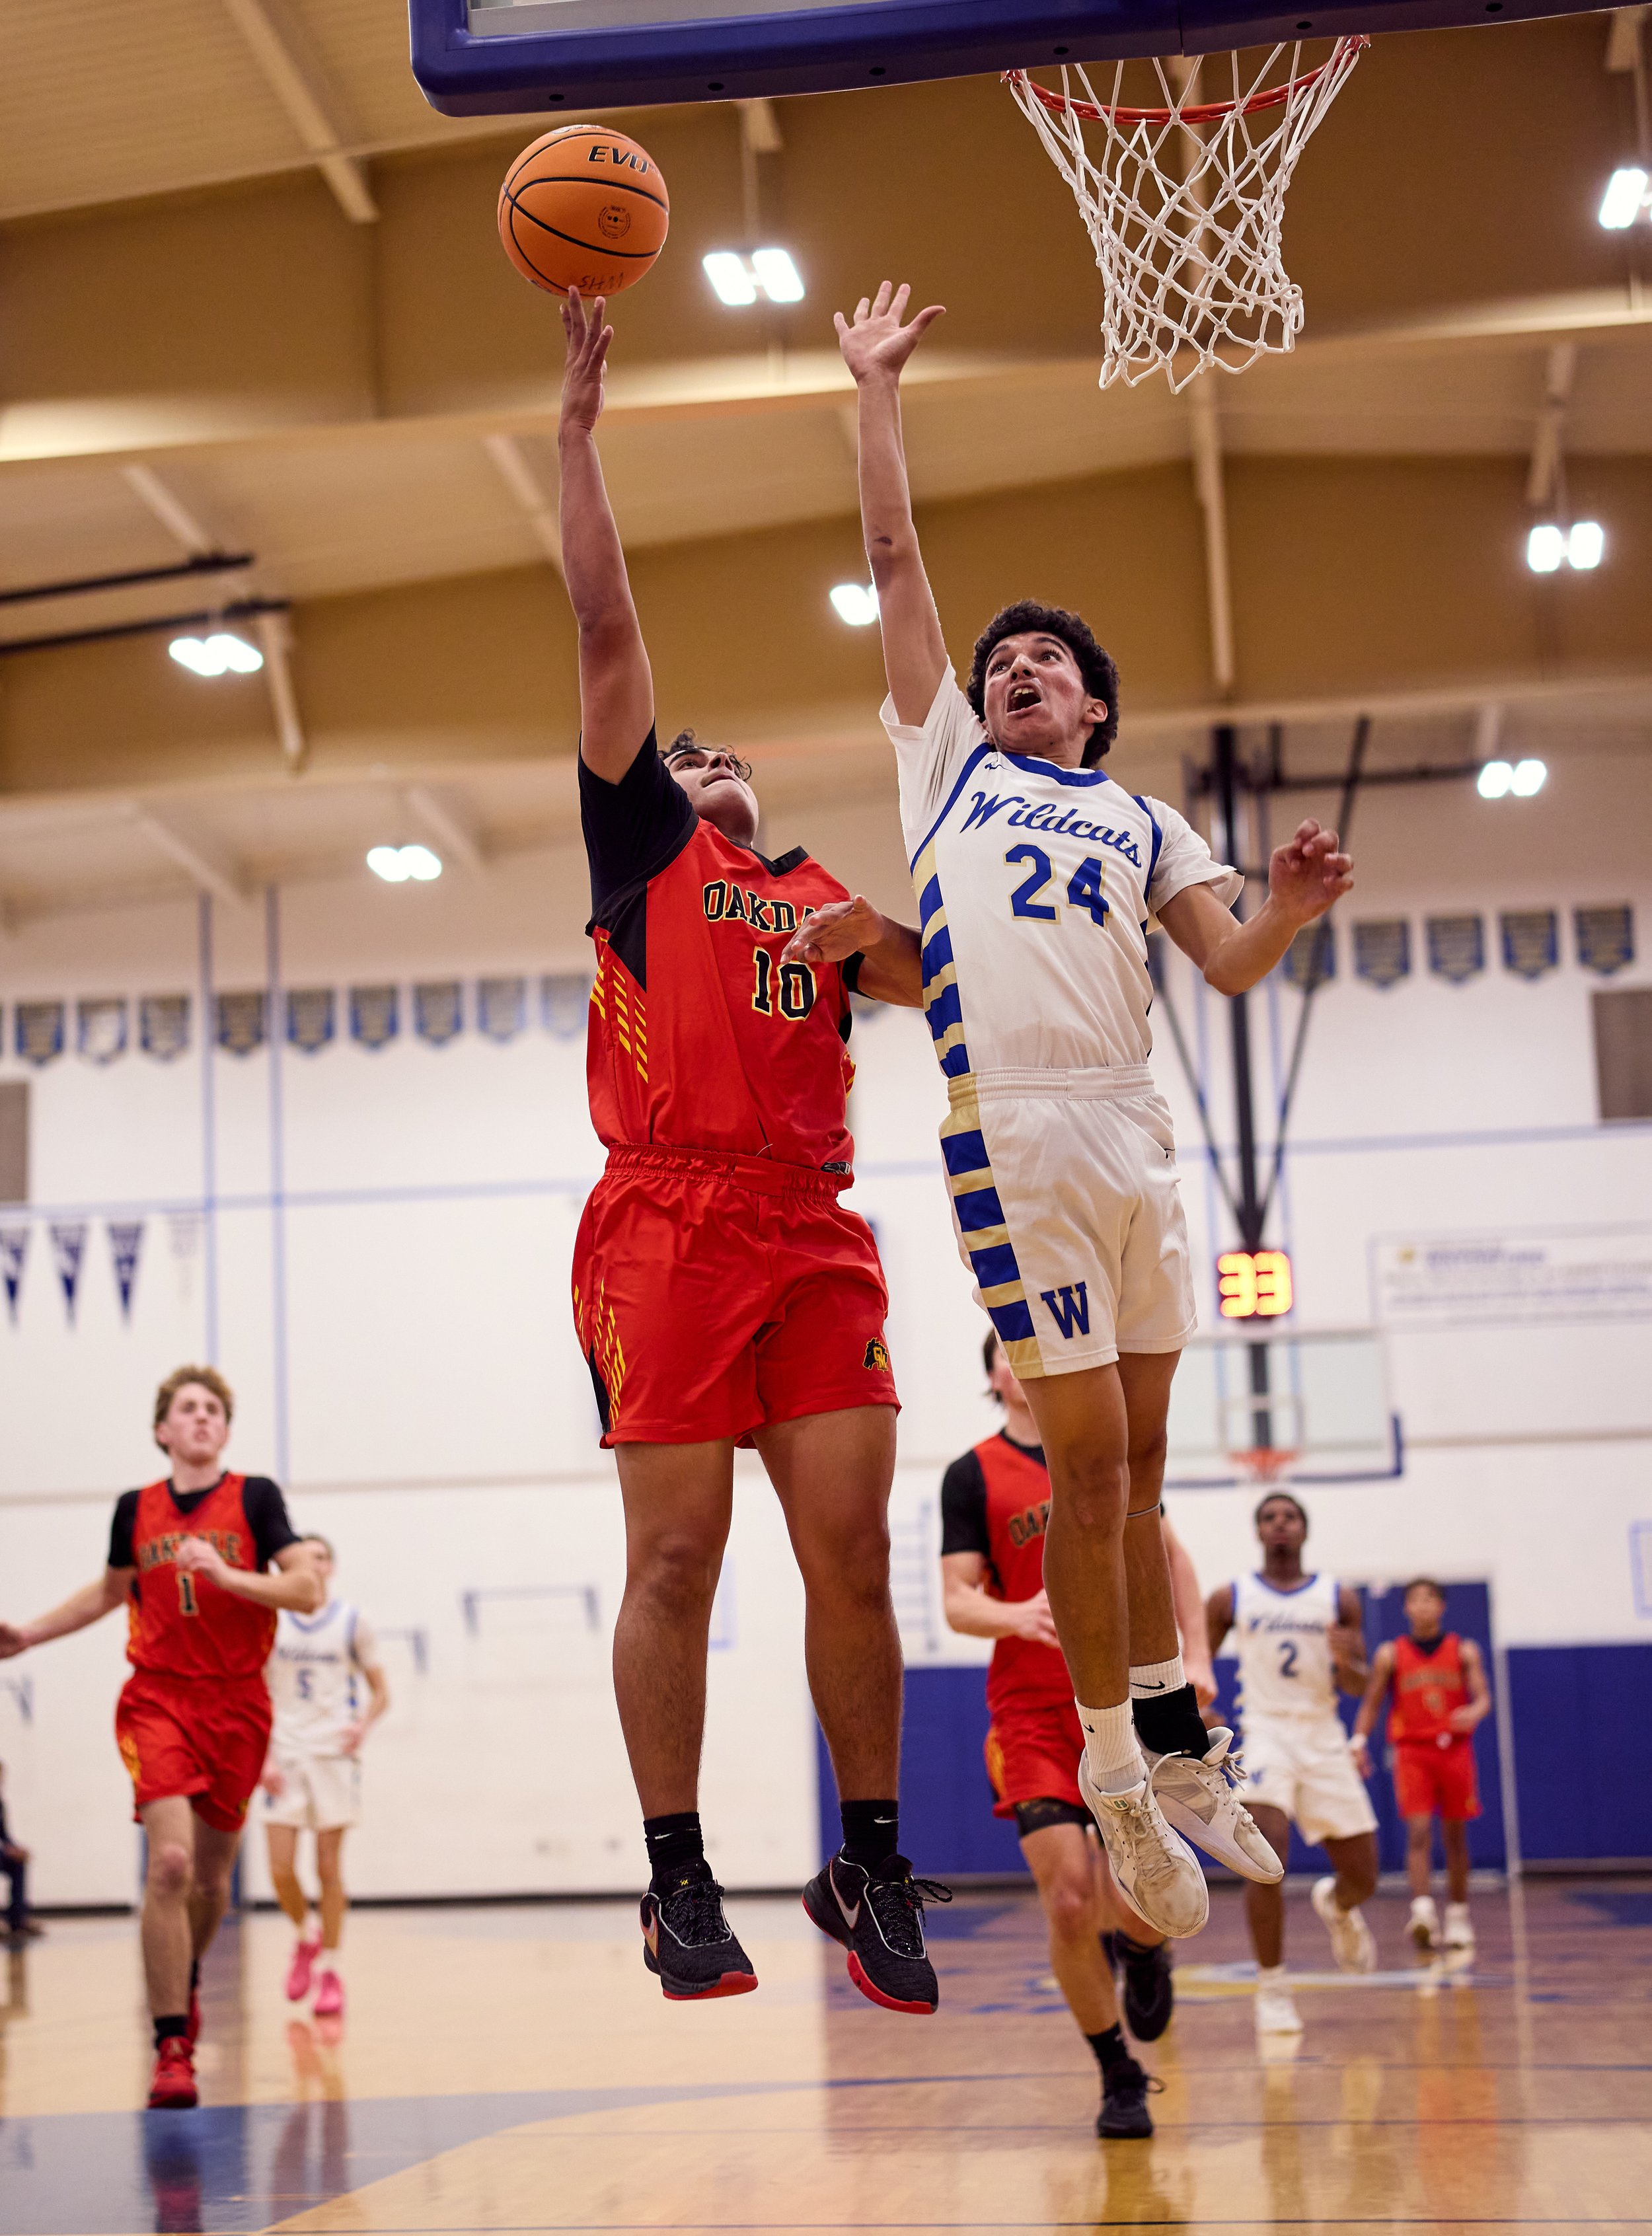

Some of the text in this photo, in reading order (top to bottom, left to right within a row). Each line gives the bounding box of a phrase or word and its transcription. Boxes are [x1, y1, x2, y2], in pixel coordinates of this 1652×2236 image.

[587, 145, 648, 174] EVO
[959, 792, 1142, 868] Wildcats
[1003, 842, 1113, 932] 24
[751, 946, 817, 1022] 10
[1039, 1281, 1090, 1339] W
[1217, 1250, 1293, 1318] 33
[176, 1570, 199, 1617] 1
[1278, 1639, 1300, 1678] 2
